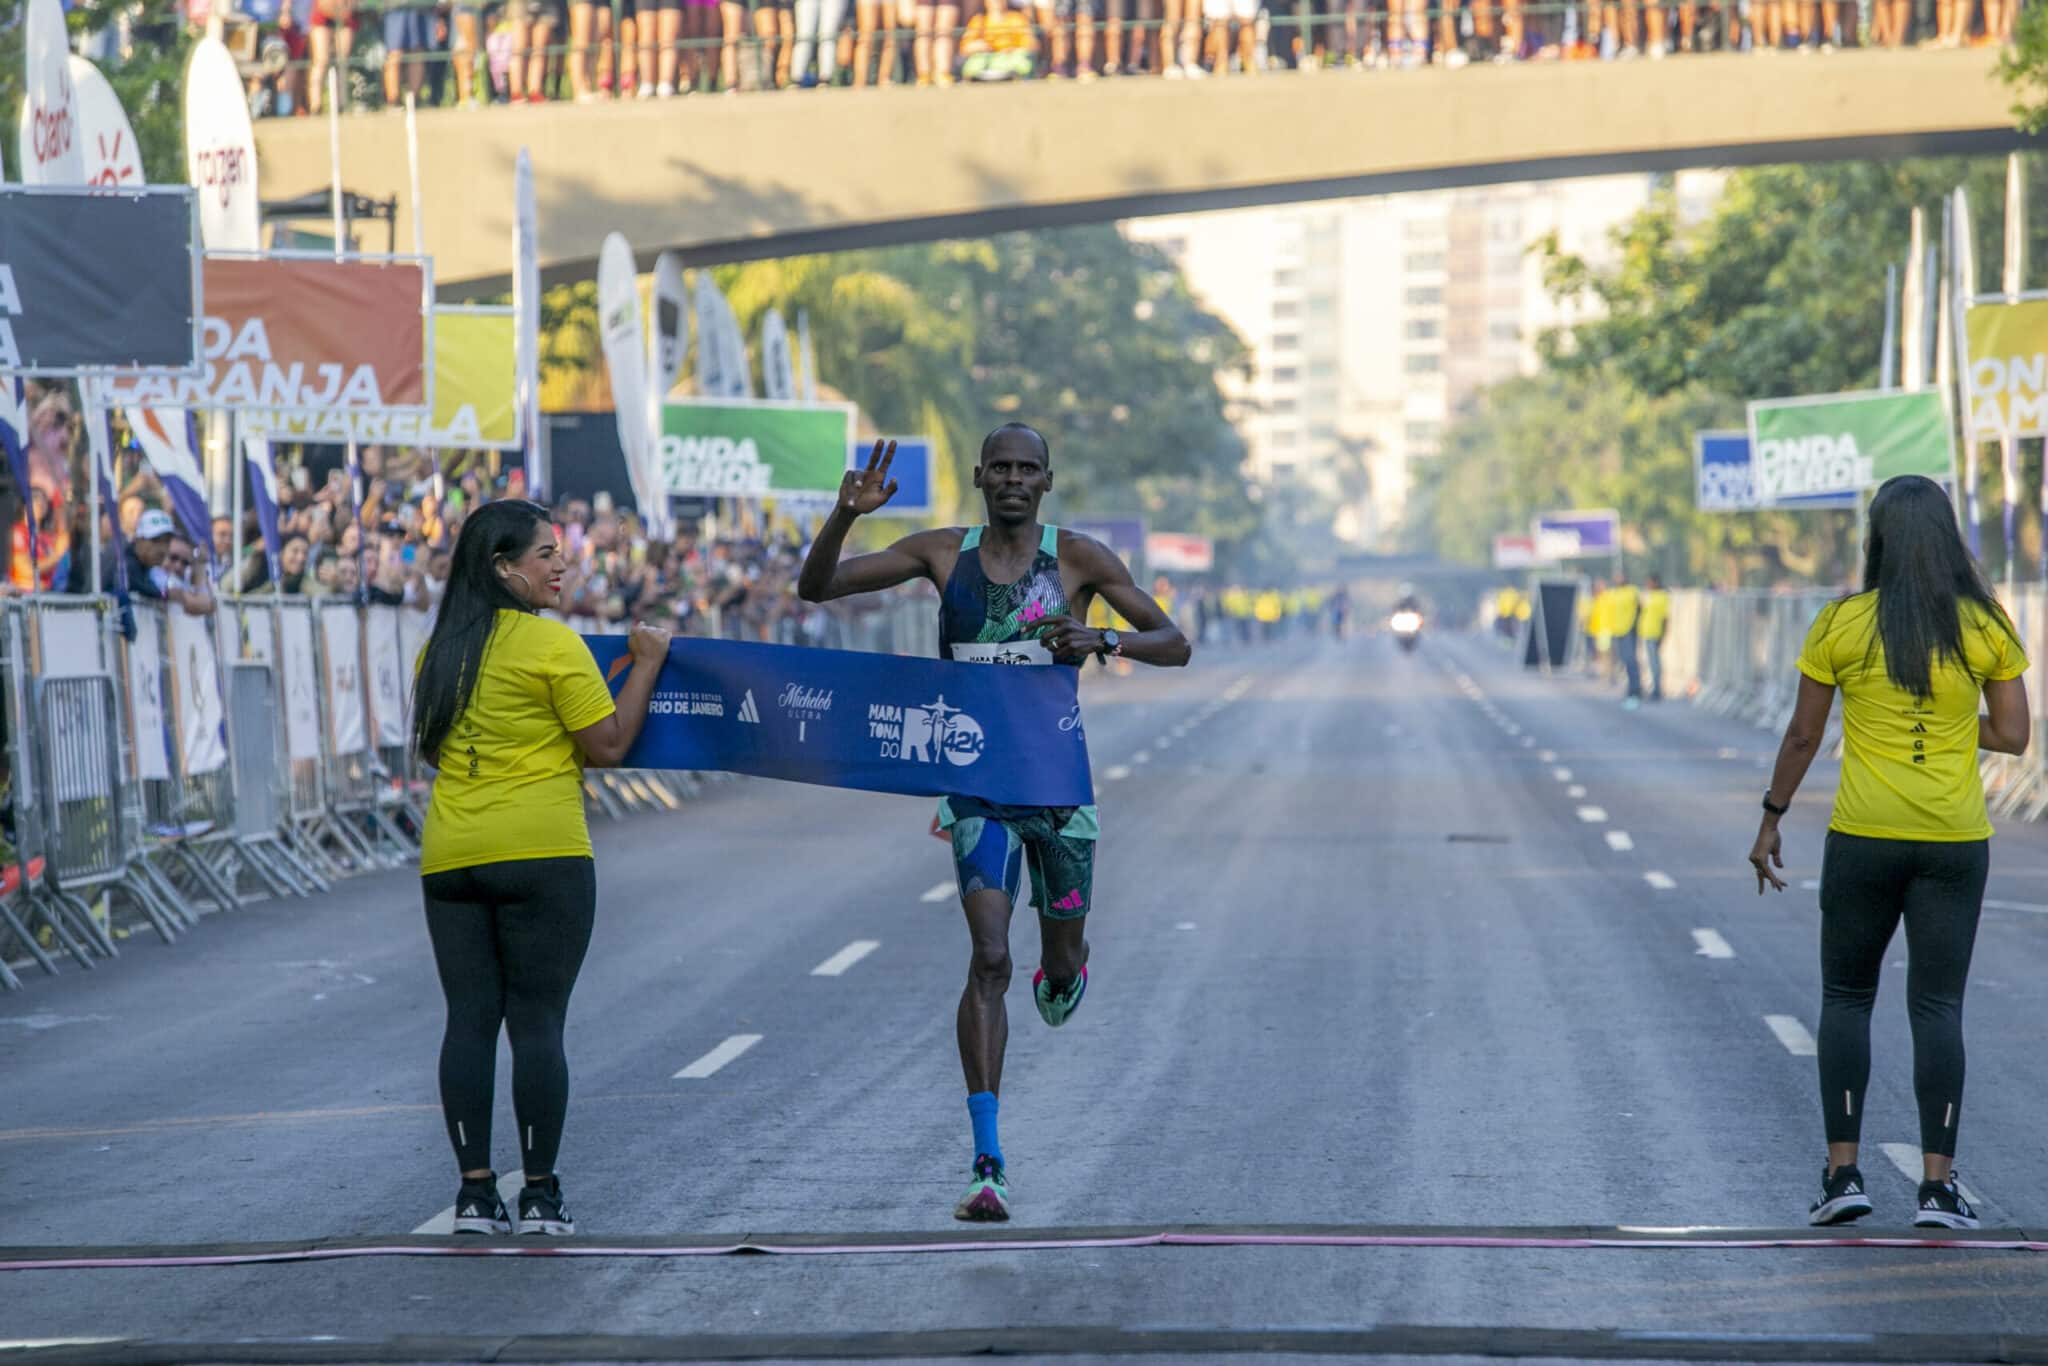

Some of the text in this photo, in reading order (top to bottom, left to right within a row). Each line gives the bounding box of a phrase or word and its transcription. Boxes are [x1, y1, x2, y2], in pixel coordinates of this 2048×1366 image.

[658, 434, 760, 464] ONDA
[1757, 433, 1858, 471] ONDA
[777, 682, 833, 711] Michelob
[649, 701, 673, 714] RIO
[674, 702, 689, 714] DE
[787, 709, 822, 721] ULTRA
[868, 703, 902, 722] MARA
[869, 722, 900, 740] TONA
[880, 740, 900, 759] DO
